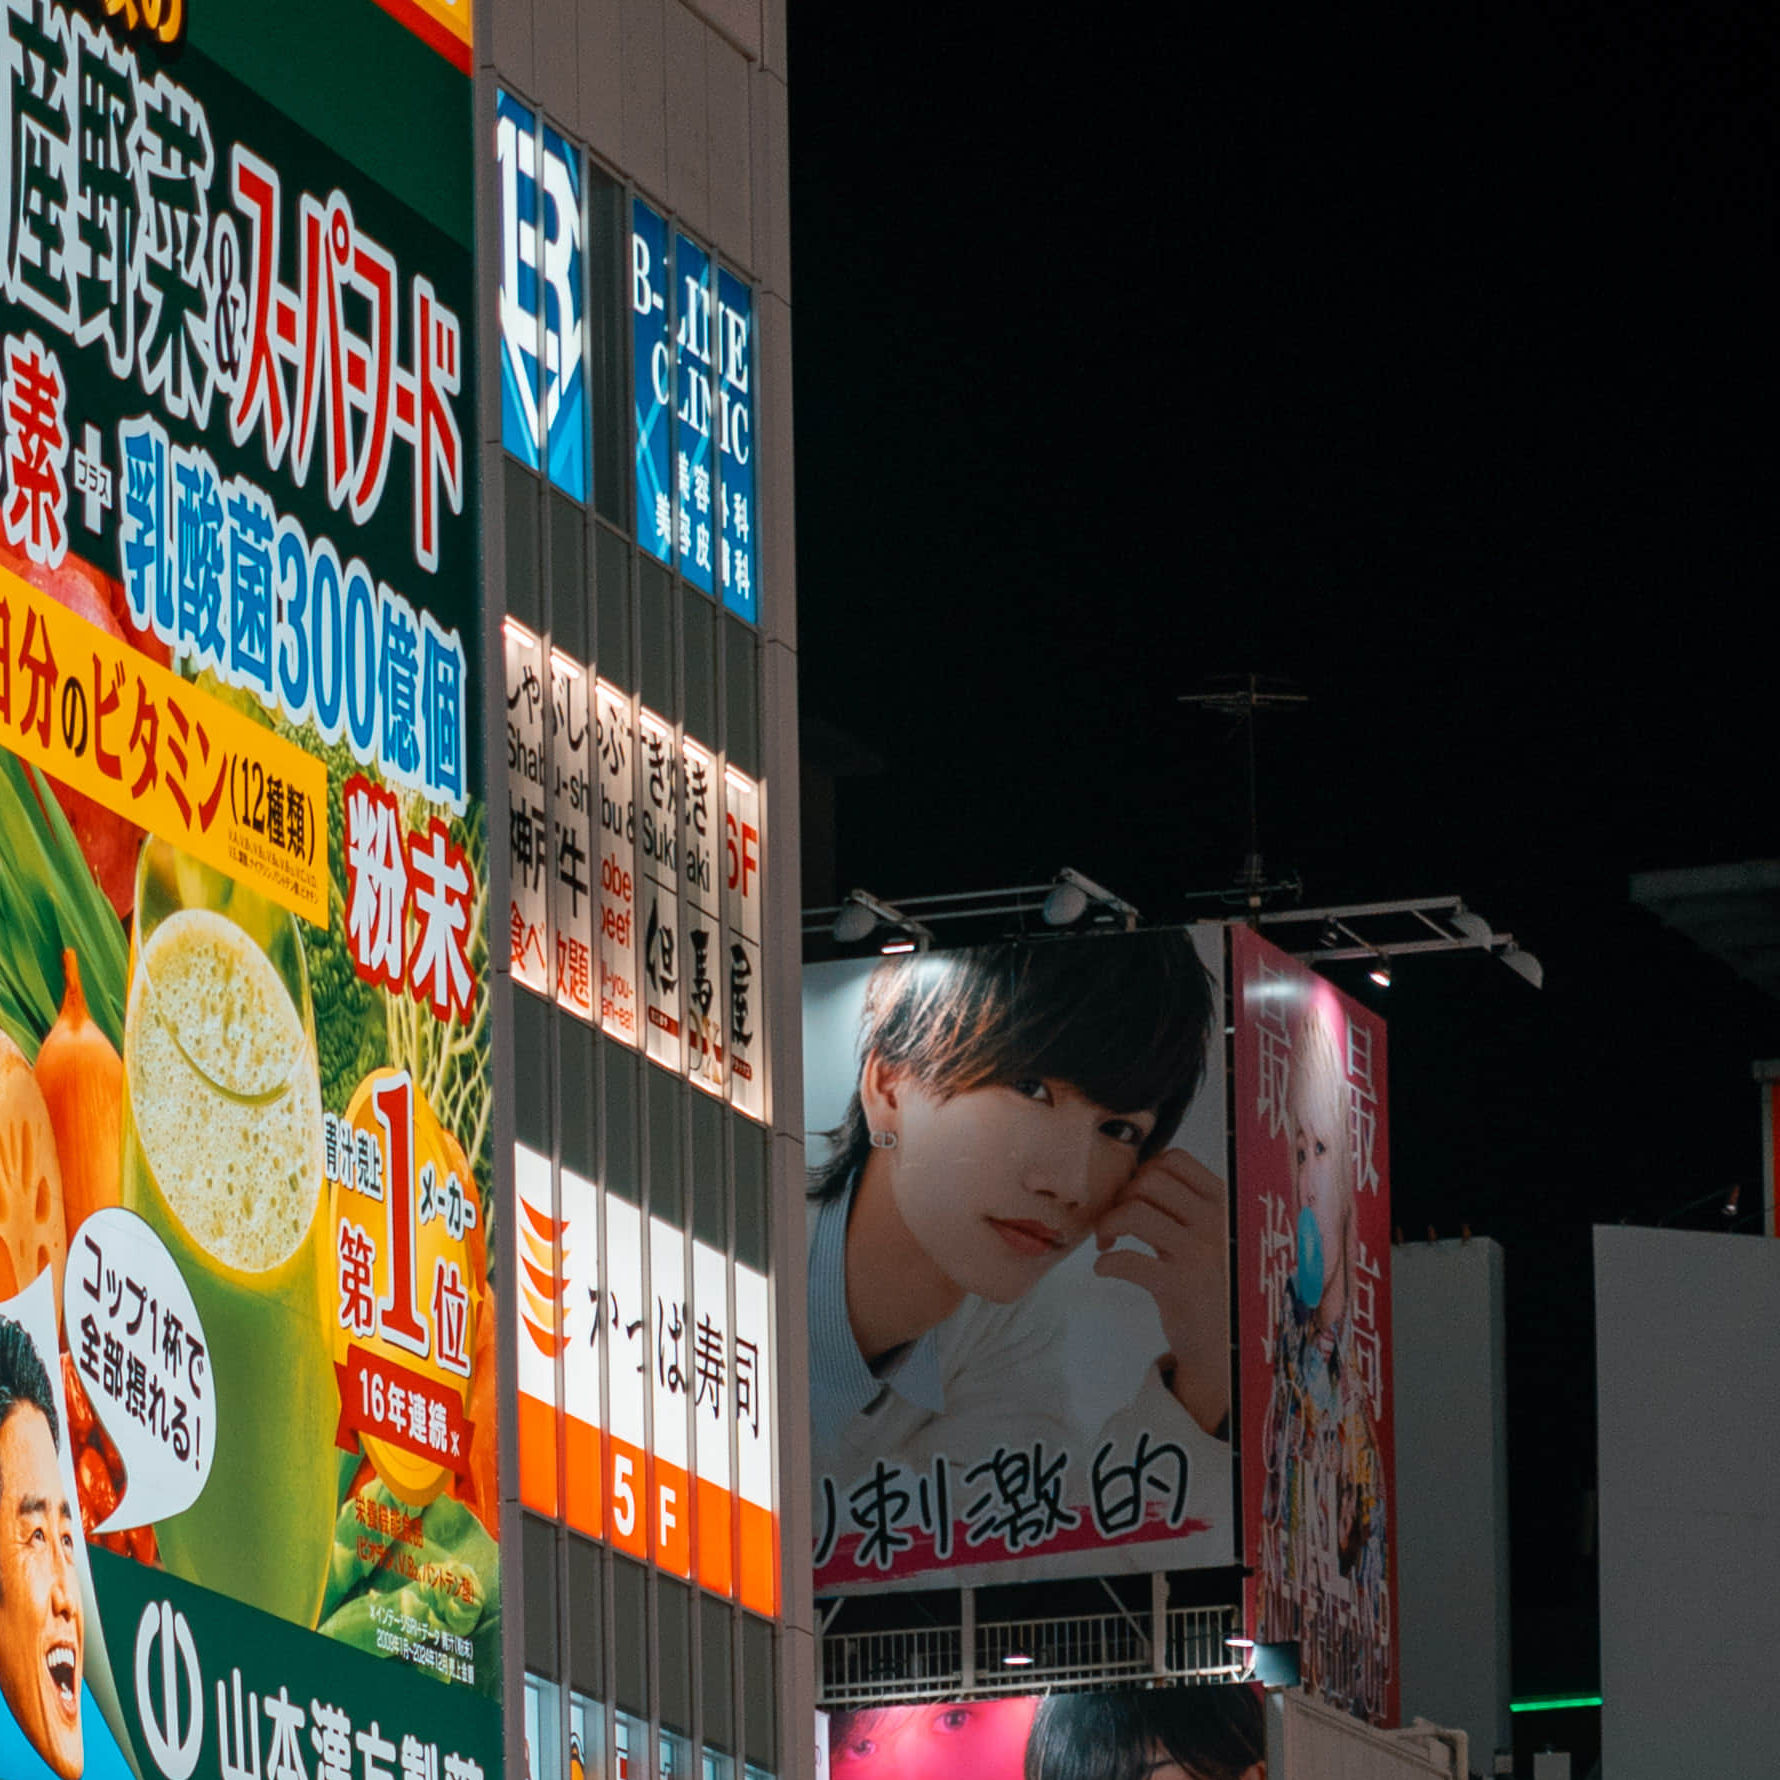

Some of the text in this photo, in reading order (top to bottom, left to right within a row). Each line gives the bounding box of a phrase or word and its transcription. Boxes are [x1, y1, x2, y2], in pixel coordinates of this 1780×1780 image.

[345, 772, 477, 1026] 粉末
[601, 852, 633, 903] obe
[83, 1234, 205, 1392] コップ1杯で
